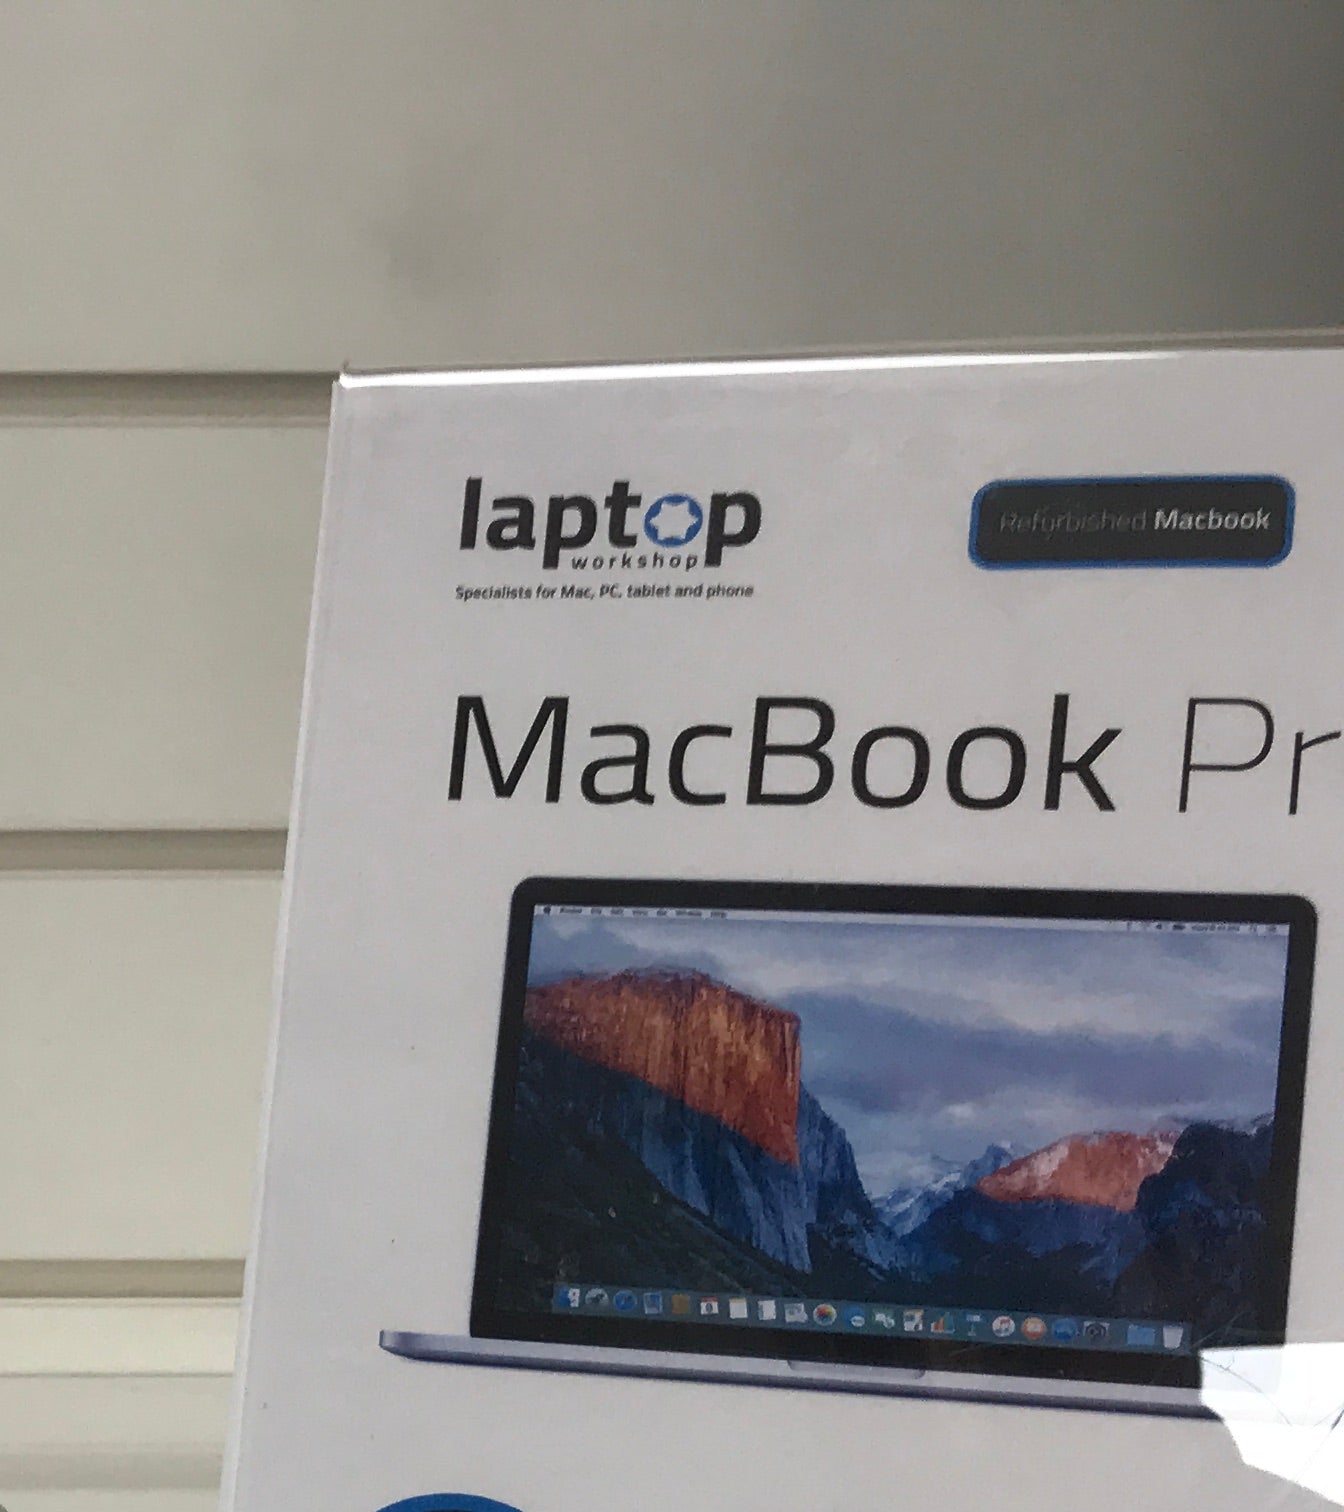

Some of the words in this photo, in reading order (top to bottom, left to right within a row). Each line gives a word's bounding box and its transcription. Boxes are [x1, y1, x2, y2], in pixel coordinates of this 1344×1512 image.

[460, 477, 762, 570] laptop
[1154, 508, 1272, 531] Macbook
[571, 552, 698, 572] workshop
[455, 584, 531, 602] Specialists
[536, 585, 556, 600] for
[561, 585, 594, 601] Mac,
[627, 584, 671, 599] tablet
[675, 584, 703, 599] and
[706, 585, 754, 601] phone
[448, 694, 1122, 811] MacBook
[1179, 697, 1342, 816] Pr
